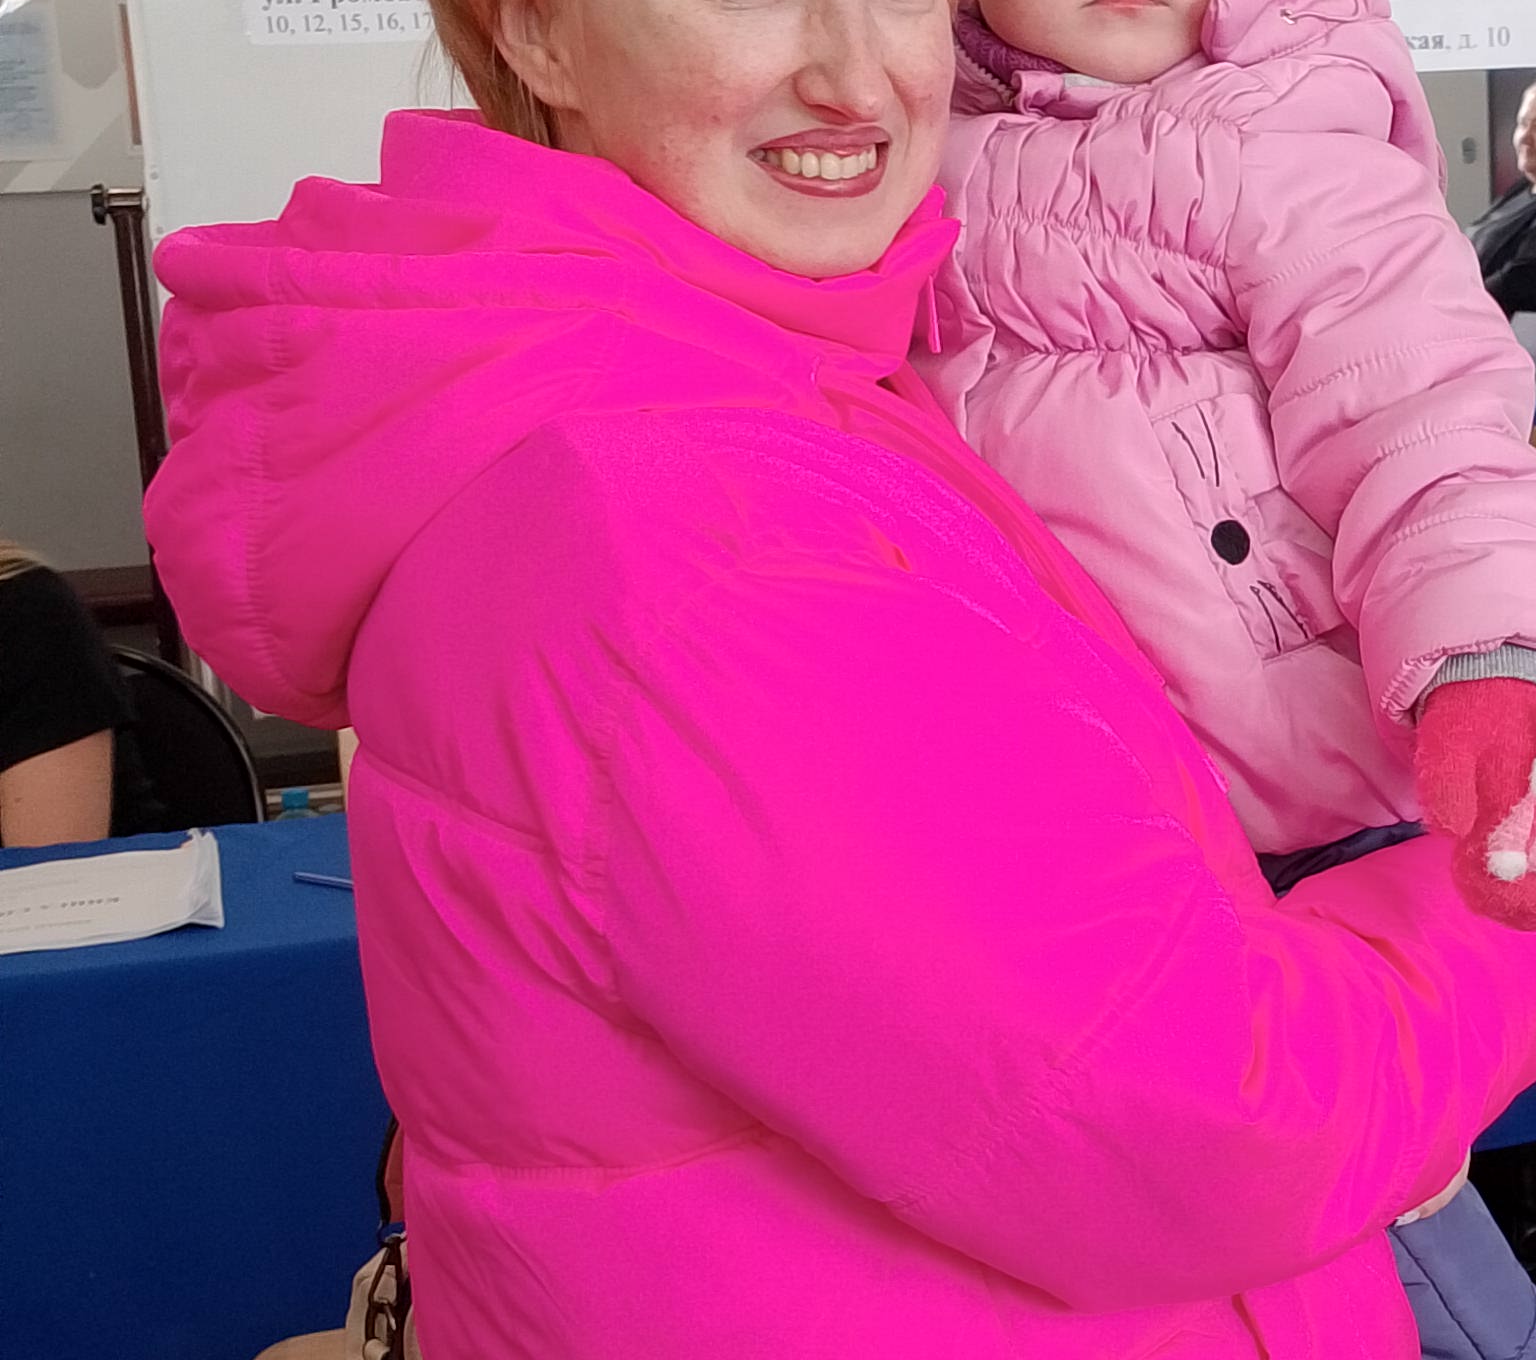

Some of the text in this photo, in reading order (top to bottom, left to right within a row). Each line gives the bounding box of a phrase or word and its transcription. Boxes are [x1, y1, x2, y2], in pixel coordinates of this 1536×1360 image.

[266, 15, 296, 35] 10,
[303, 14, 333, 34] 12,
[341, 13, 370, 33] 15,
[377, 12, 405, 32] 16,
[1487, 25, 1511, 48] 10
